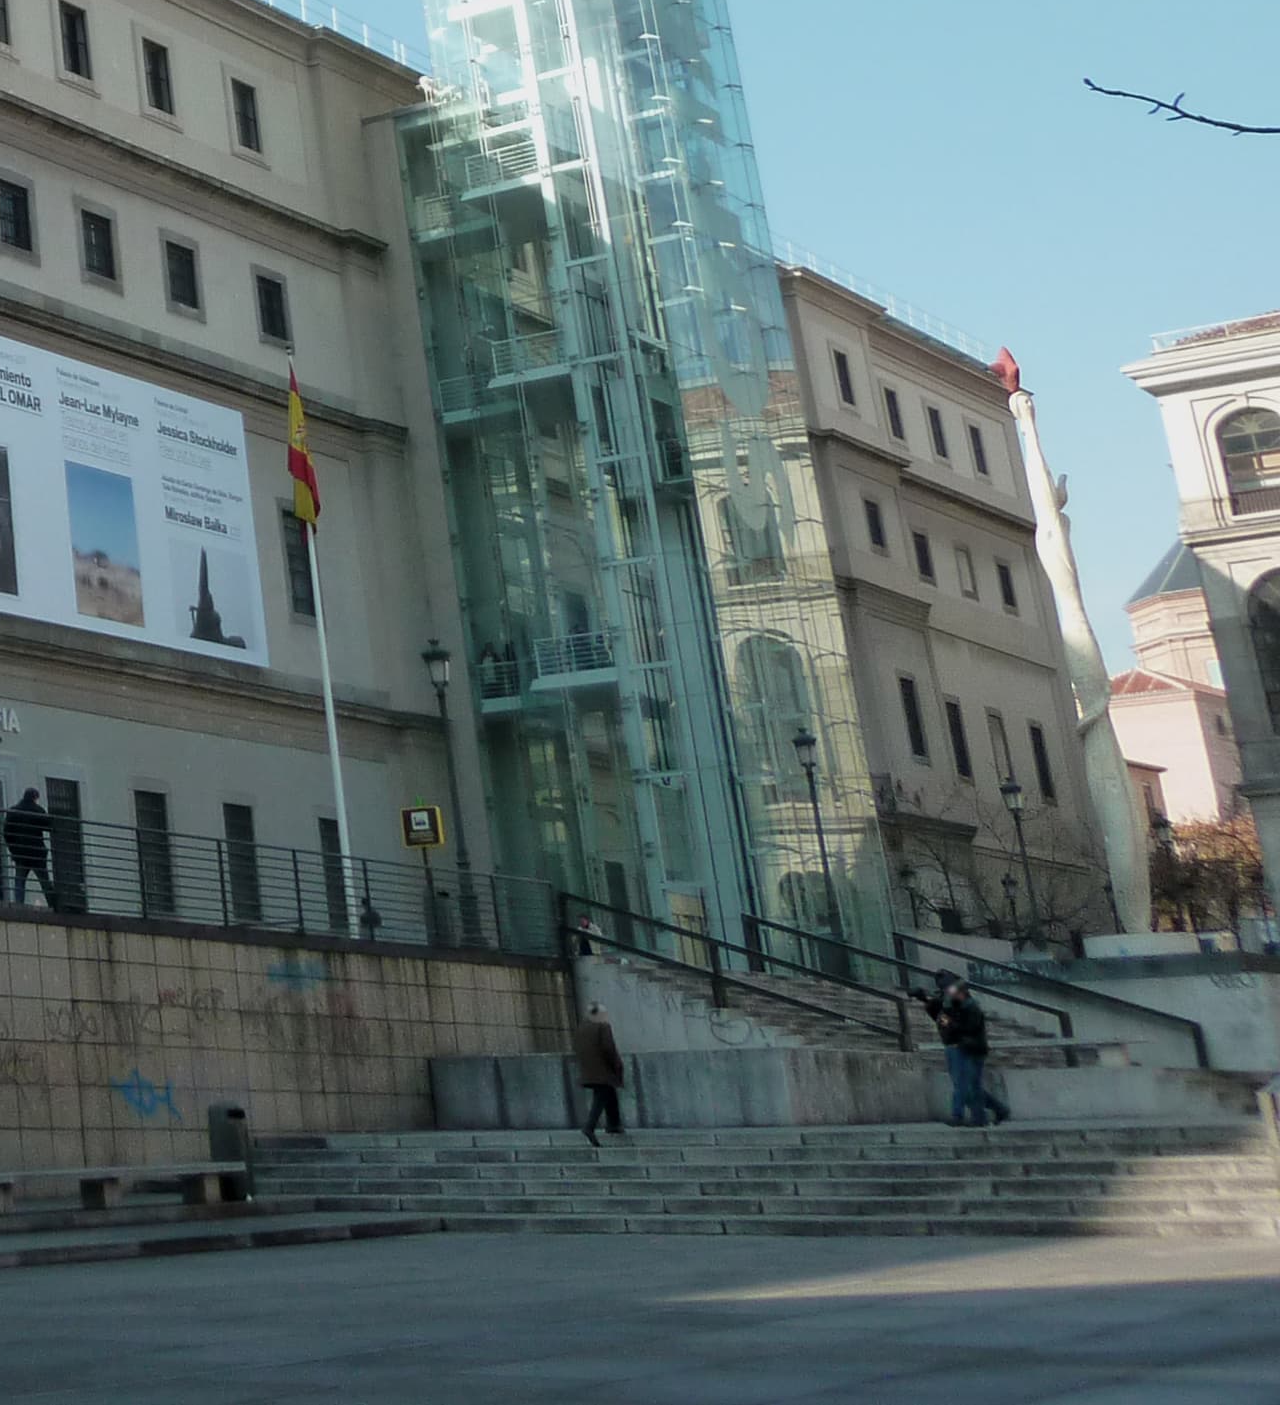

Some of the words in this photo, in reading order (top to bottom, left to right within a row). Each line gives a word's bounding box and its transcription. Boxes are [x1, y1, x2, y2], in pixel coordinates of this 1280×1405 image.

[8, 388, 43, 413] OMAR
[58, 391, 102, 416] Jean-Luc
[157, 420, 189, 443] Jessica
[189, 429, 238, 457] Stockholder
